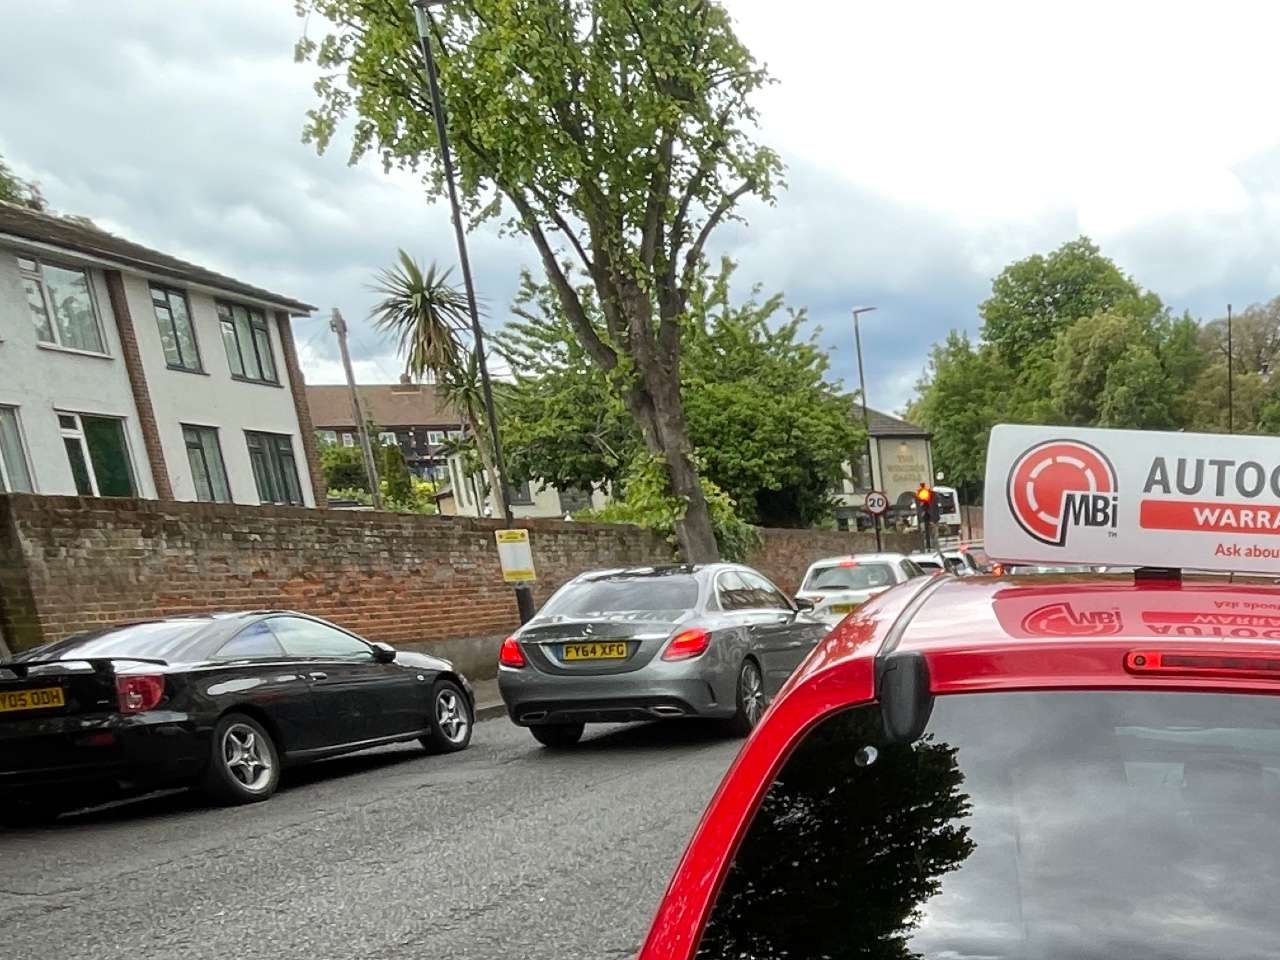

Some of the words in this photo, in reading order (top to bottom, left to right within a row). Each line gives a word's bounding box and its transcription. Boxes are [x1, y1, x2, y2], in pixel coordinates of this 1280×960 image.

[869, 497, 883, 507] 20
[1066, 493, 1118, 528] MBi
[1215, 543, 1241, 557] Ask
[565, 645, 597, 657] FY64
[600, 644, 624, 656] XFG
